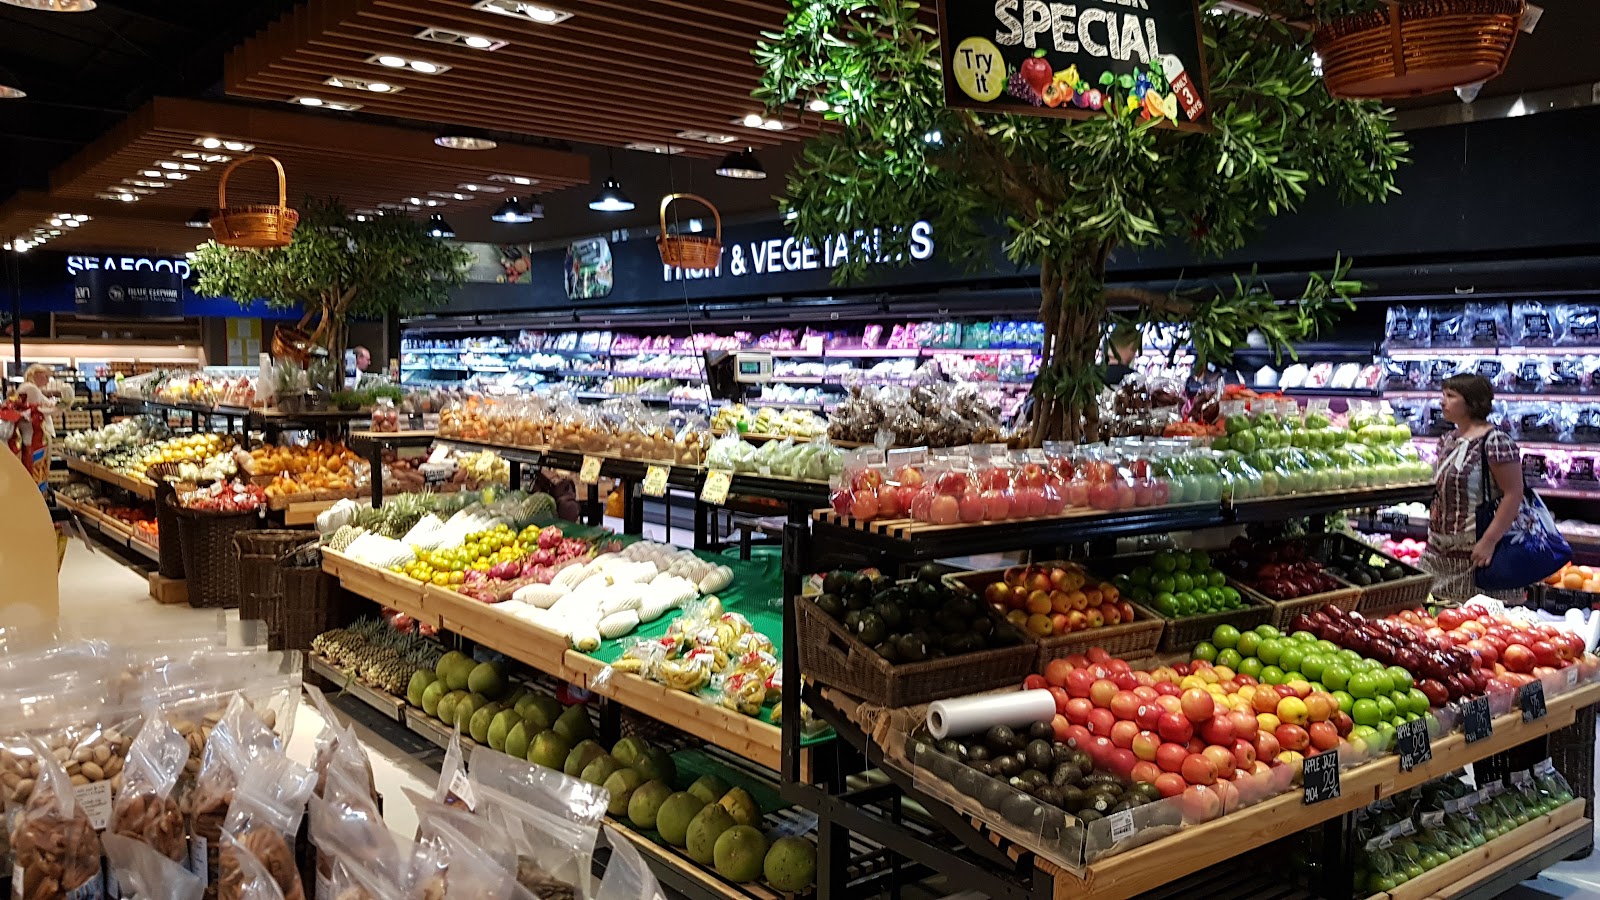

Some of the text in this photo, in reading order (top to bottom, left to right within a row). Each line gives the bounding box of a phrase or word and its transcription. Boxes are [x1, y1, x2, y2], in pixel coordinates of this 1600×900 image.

[994, 0, 1165, 66] SPECIAL
[960, 48, 992, 74] Try
[975, 72, 989, 93] it
[1172, 73, 1188, 94] ONLY
[1182, 87, 1194, 106] 3
[1186, 99, 1203, 120] DAYS
[731, 244, 746, 276] &
[1412, 731, 1426, 757] 29
[1304, 752, 1337, 775] APPLE JAZZ
[1322, 767, 1336, 793] 29
